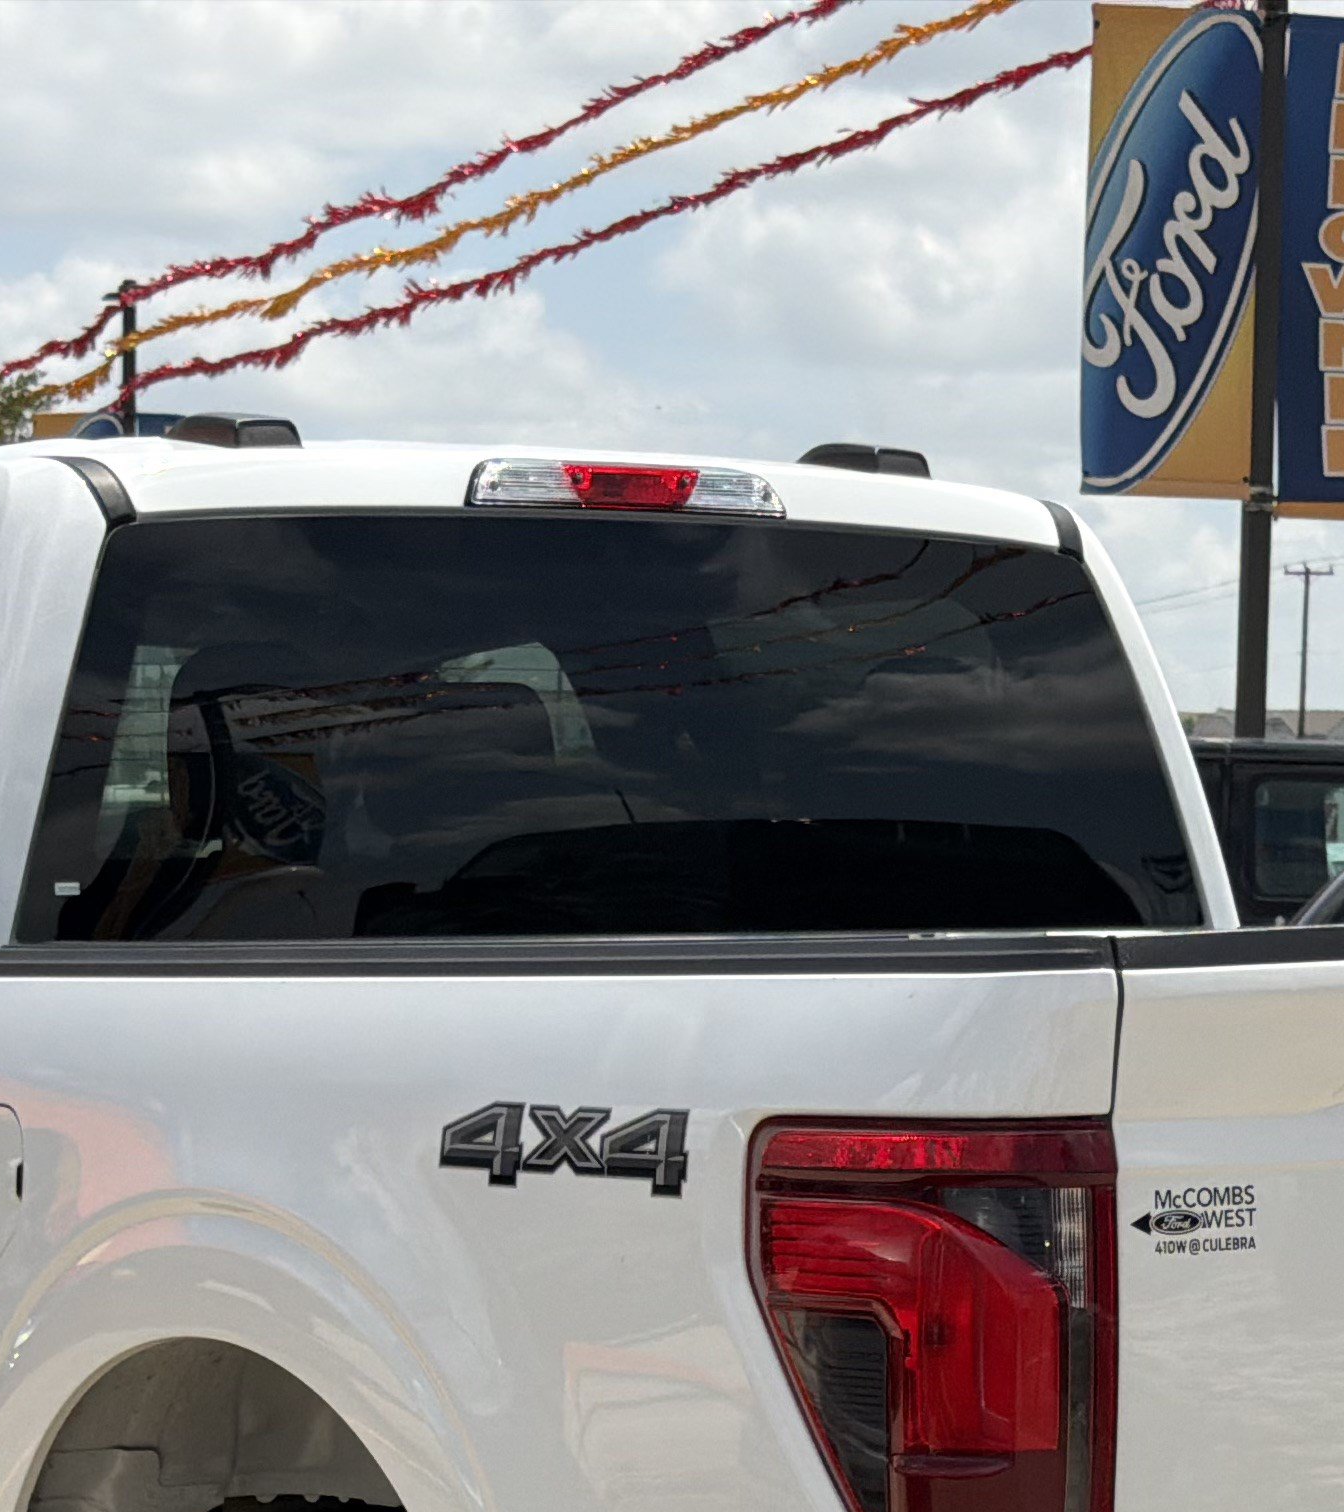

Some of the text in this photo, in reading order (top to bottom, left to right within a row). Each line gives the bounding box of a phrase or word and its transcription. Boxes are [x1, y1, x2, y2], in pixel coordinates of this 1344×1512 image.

[1082, 89, 1252, 419] Ford
[1154, 1184, 1255, 1209] McCOMBS
[1161, 1208, 1256, 1231] Ford WEST
[1203, 1236, 1256, 1253] CULEBRA
